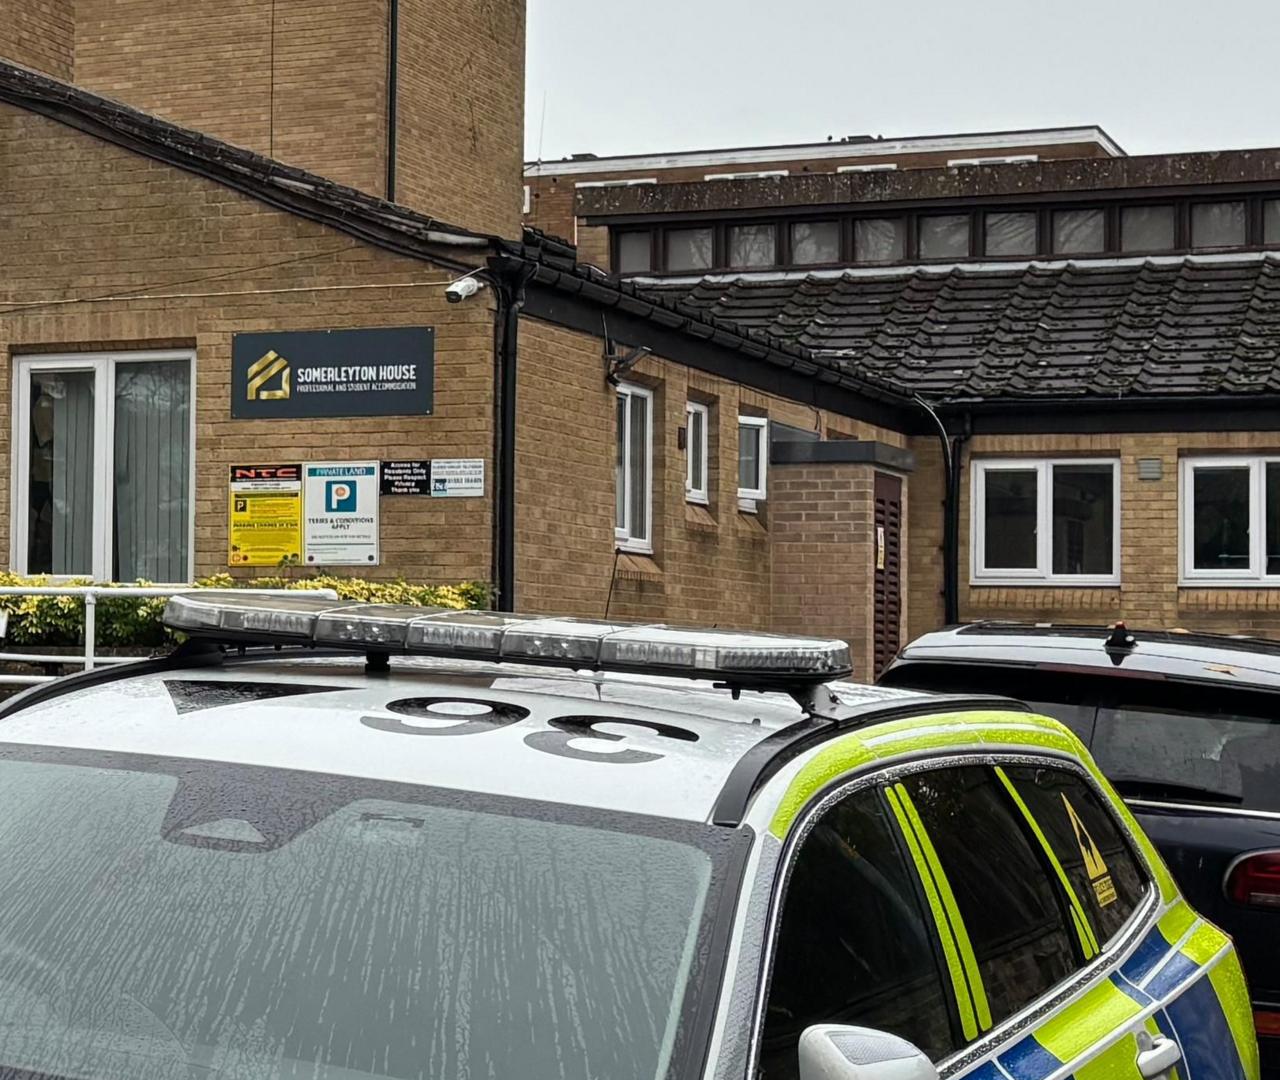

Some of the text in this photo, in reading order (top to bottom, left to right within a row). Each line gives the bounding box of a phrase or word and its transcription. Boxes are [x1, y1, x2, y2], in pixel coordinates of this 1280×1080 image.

[297, 365, 417, 382] SOMERLEYTON HOUSE
[335, 383, 347, 391] AND
[345, 467, 367, 476] LAND
